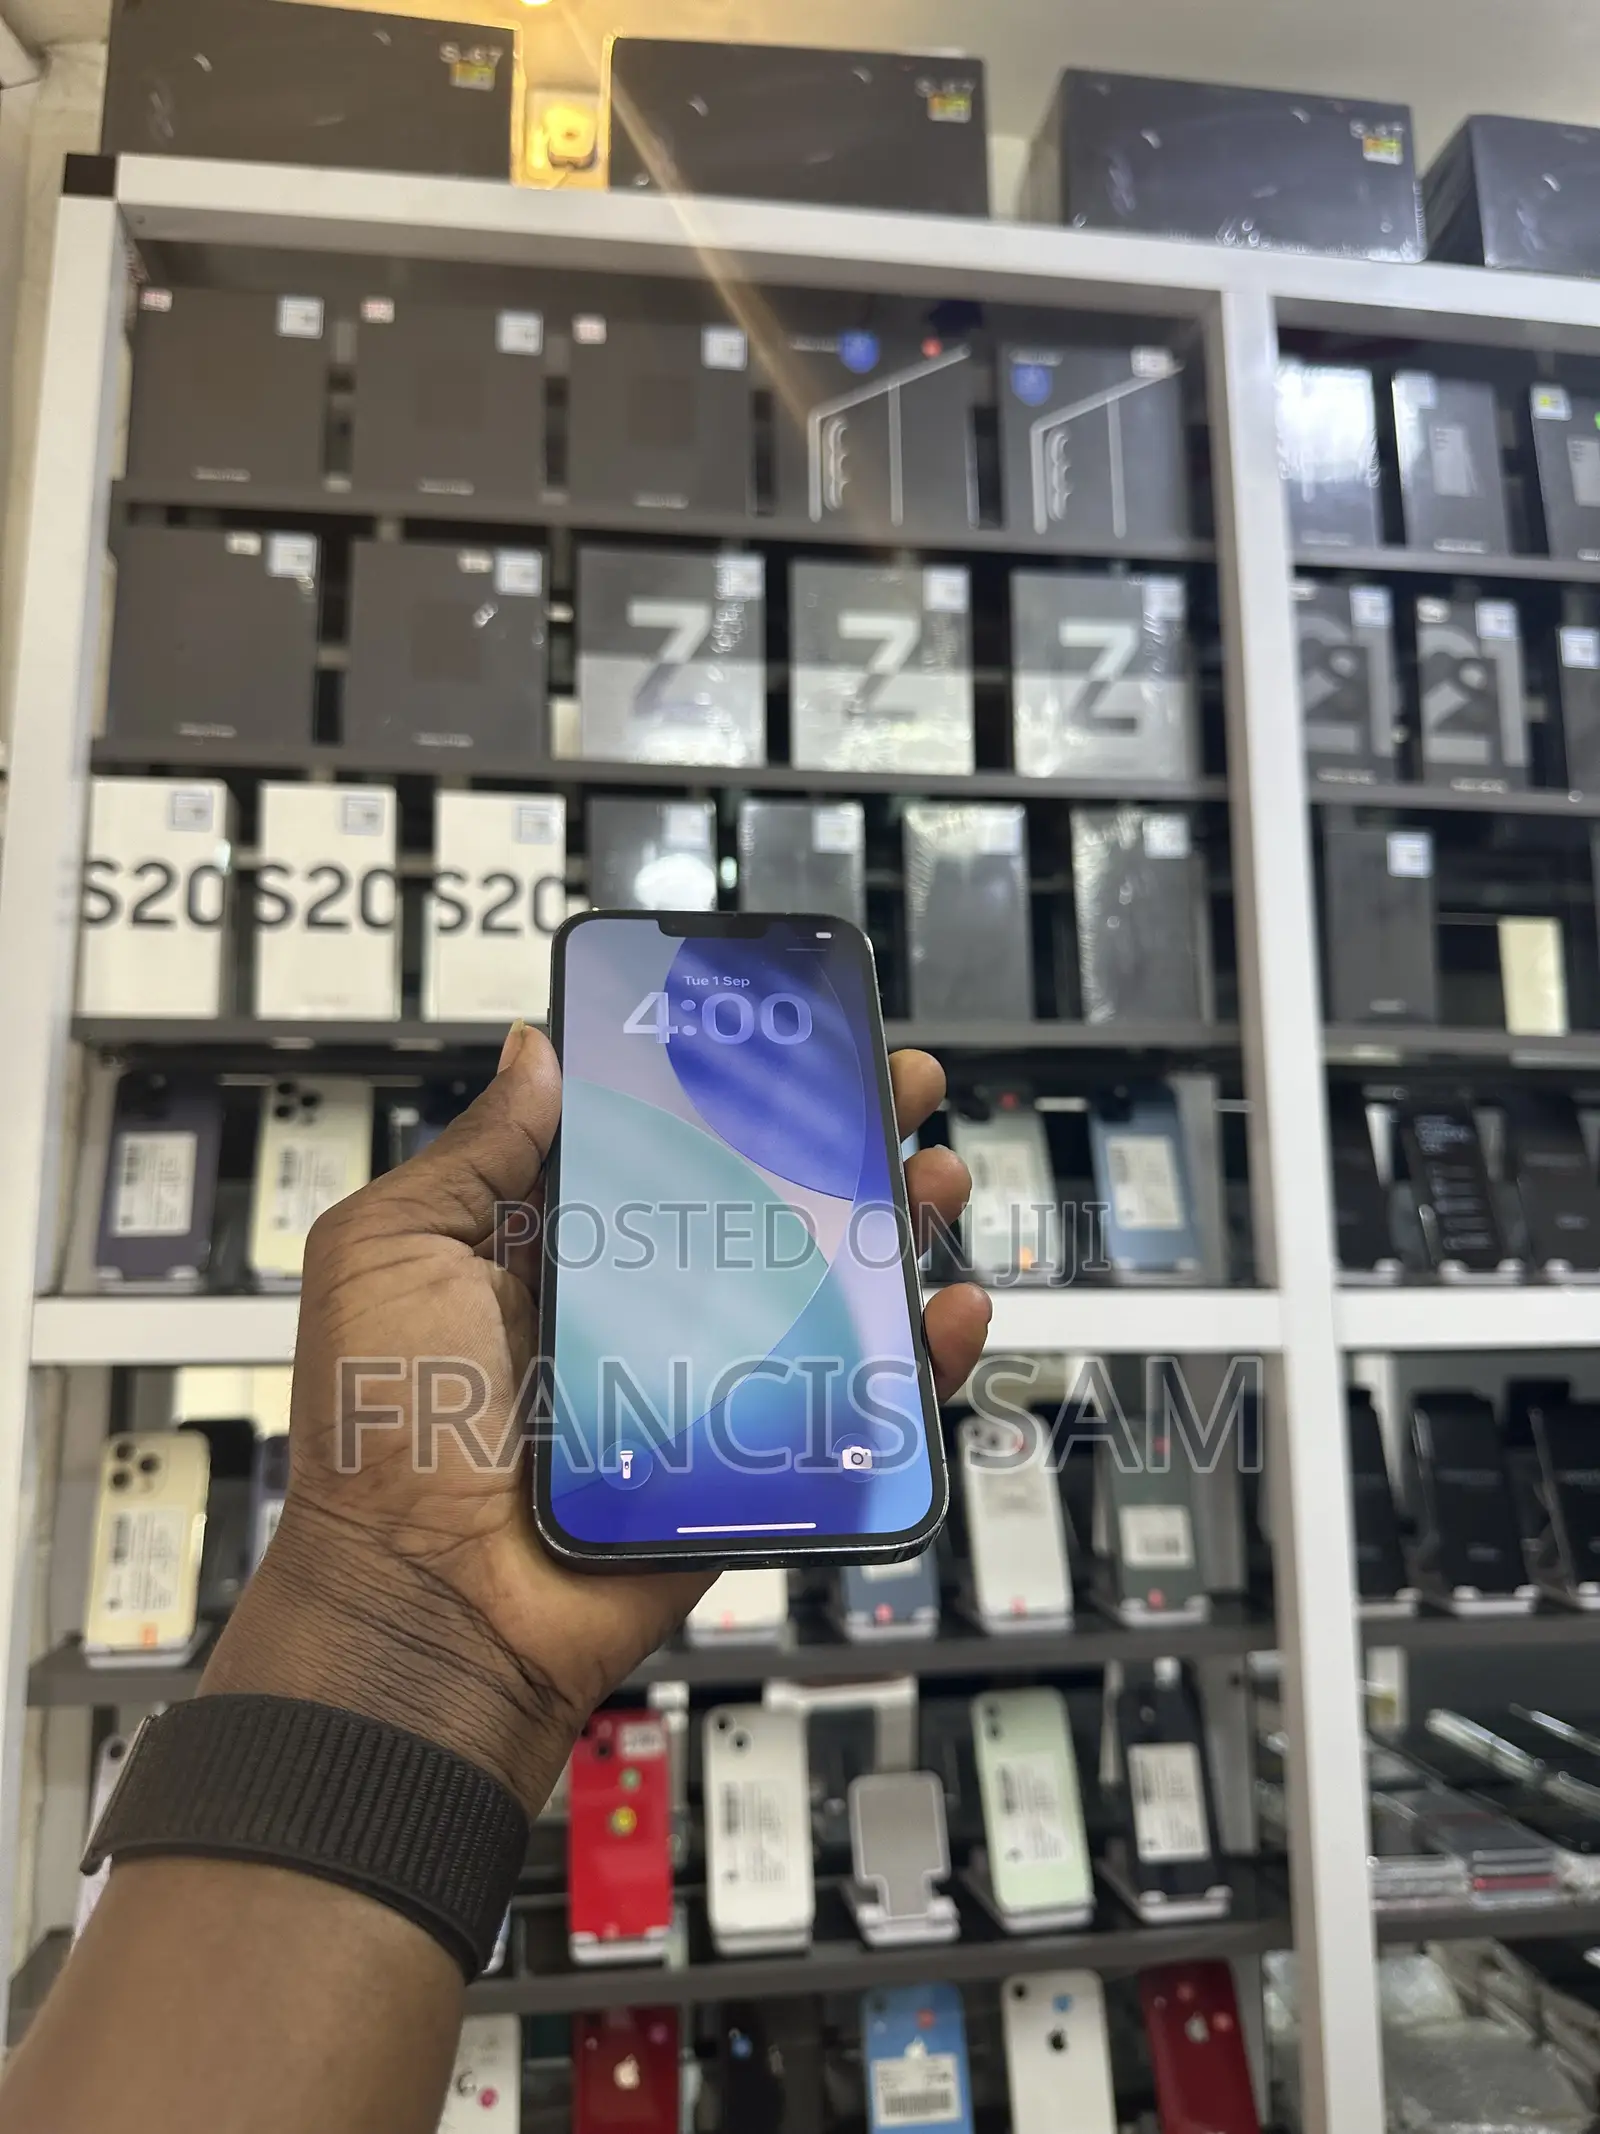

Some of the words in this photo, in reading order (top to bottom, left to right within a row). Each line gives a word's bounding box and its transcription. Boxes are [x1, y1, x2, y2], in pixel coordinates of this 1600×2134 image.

[84, 860, 226, 930] S20
[255, 862, 398, 932] S20
[684, 975, 709, 987] Tue
[712, 975, 720, 987] 1
[723, 975, 751, 988] Sep
[622, 991, 813, 1046] 4:00
